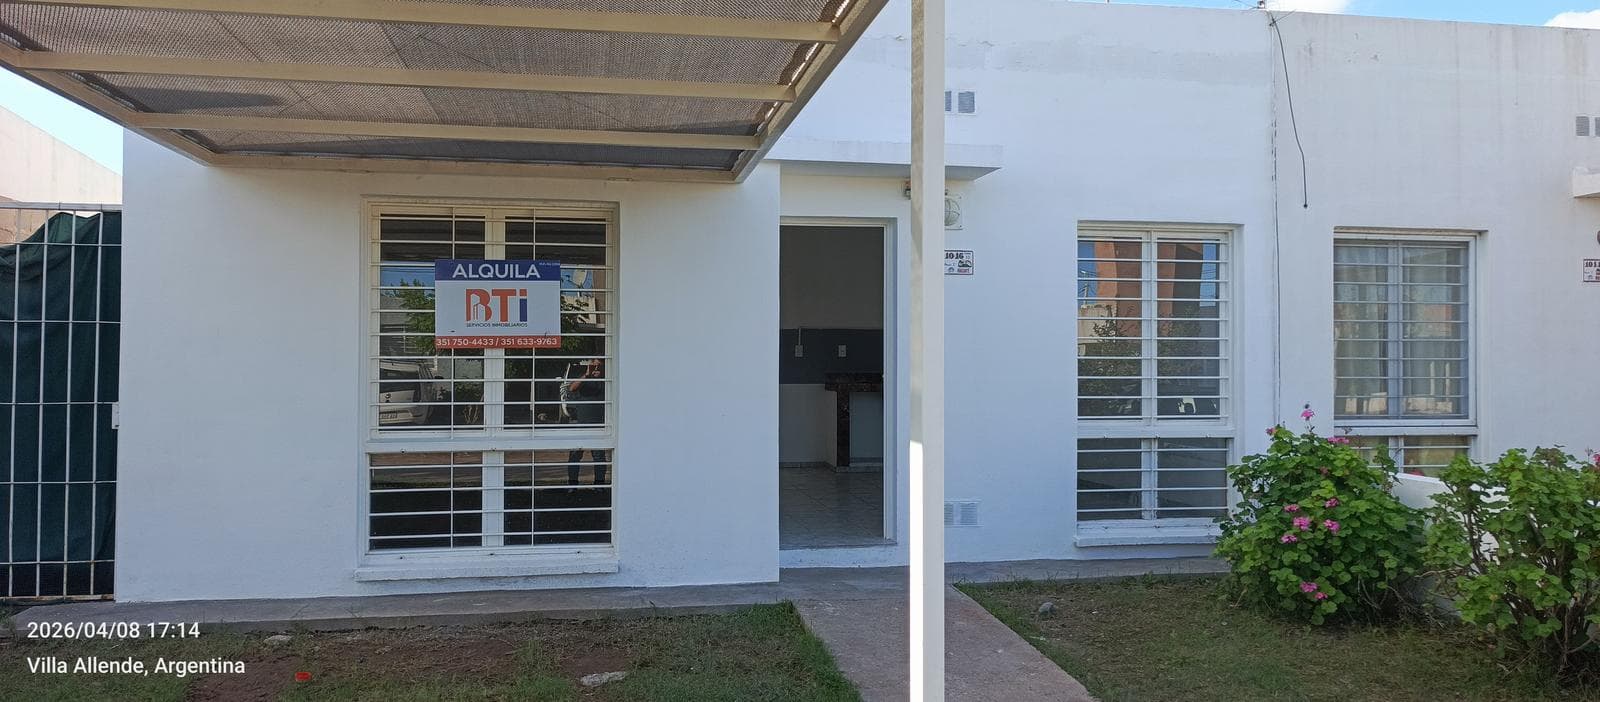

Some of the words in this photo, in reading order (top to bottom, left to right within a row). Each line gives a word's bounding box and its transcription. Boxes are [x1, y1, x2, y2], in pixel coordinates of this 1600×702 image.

[452, 263, 541, 279] ALQUILA
[436, 338, 450, 346] 351
[453, 338, 494, 346] 750-4433
[501, 338, 515, 346] 351
[517, 338, 557, 346] 633-9763
